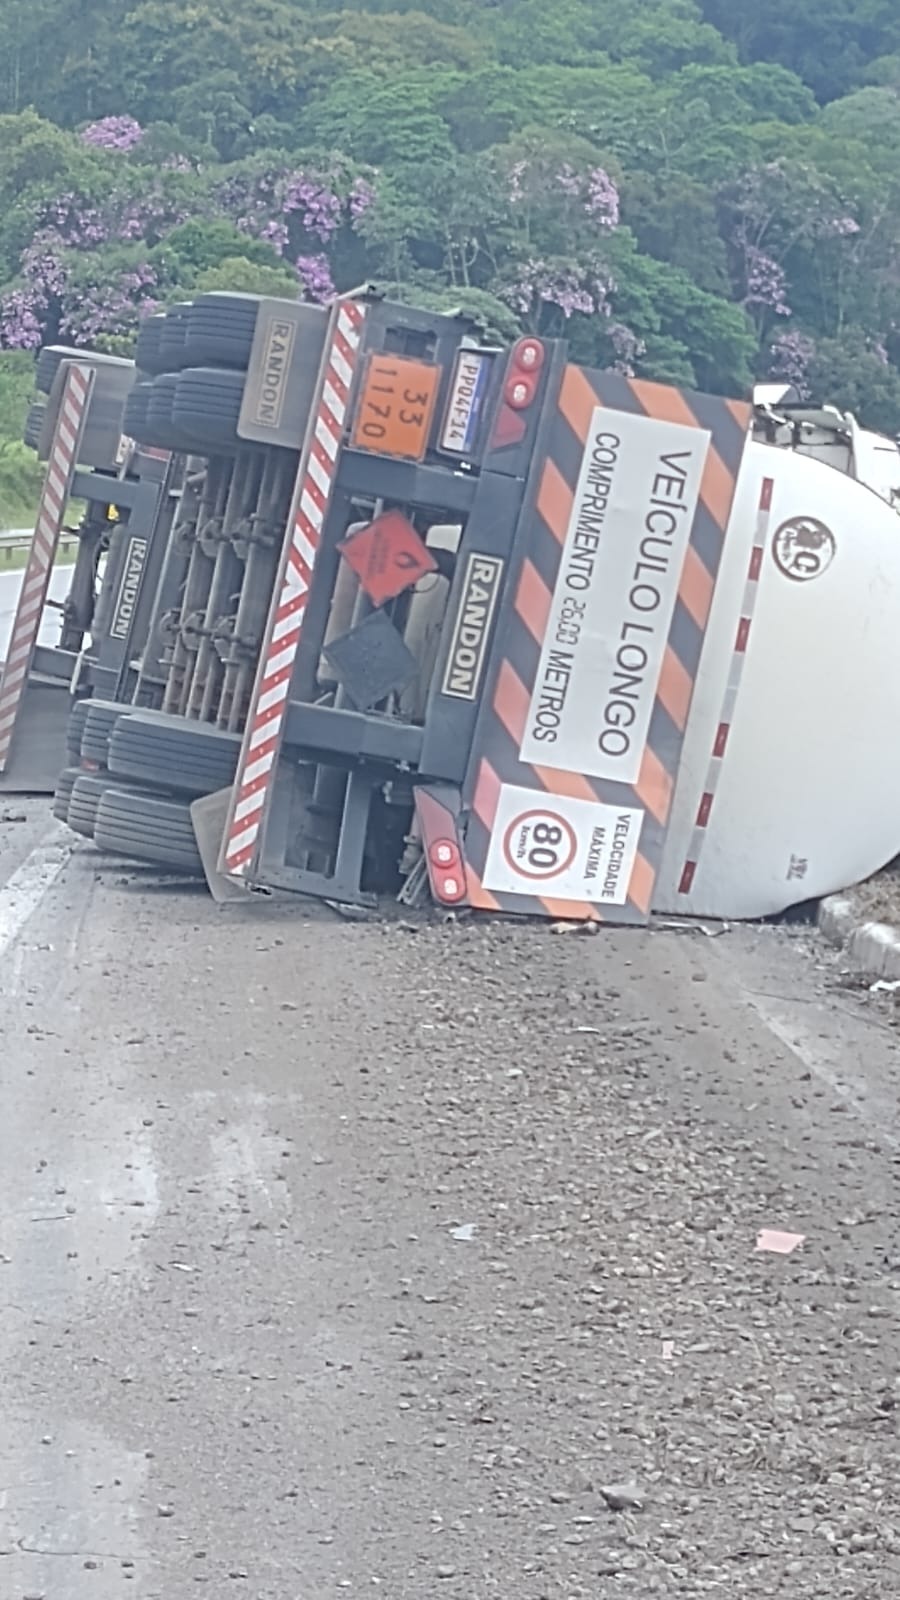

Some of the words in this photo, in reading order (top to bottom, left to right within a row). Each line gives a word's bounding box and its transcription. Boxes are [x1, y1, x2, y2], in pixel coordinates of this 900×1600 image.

[258, 324, 289, 422] RANDON
[363, 368, 397, 439] 1170
[399, 388, 428, 428] 33
[566, 432, 620, 590] COMPRIMENTO
[628, 451, 692, 612] VEÍCULO
[115, 543, 146, 637] RANDON
[450, 561, 494, 691] RANDON
[532, 649, 573, 743] METROS
[599, 622, 653, 757] LONGO
[517, 826, 530, 858] km/h
[528, 822, 562, 868] 80
[584, 827, 607, 880] MÁXIMA
[602, 814, 631, 898] VELOCIDADE
